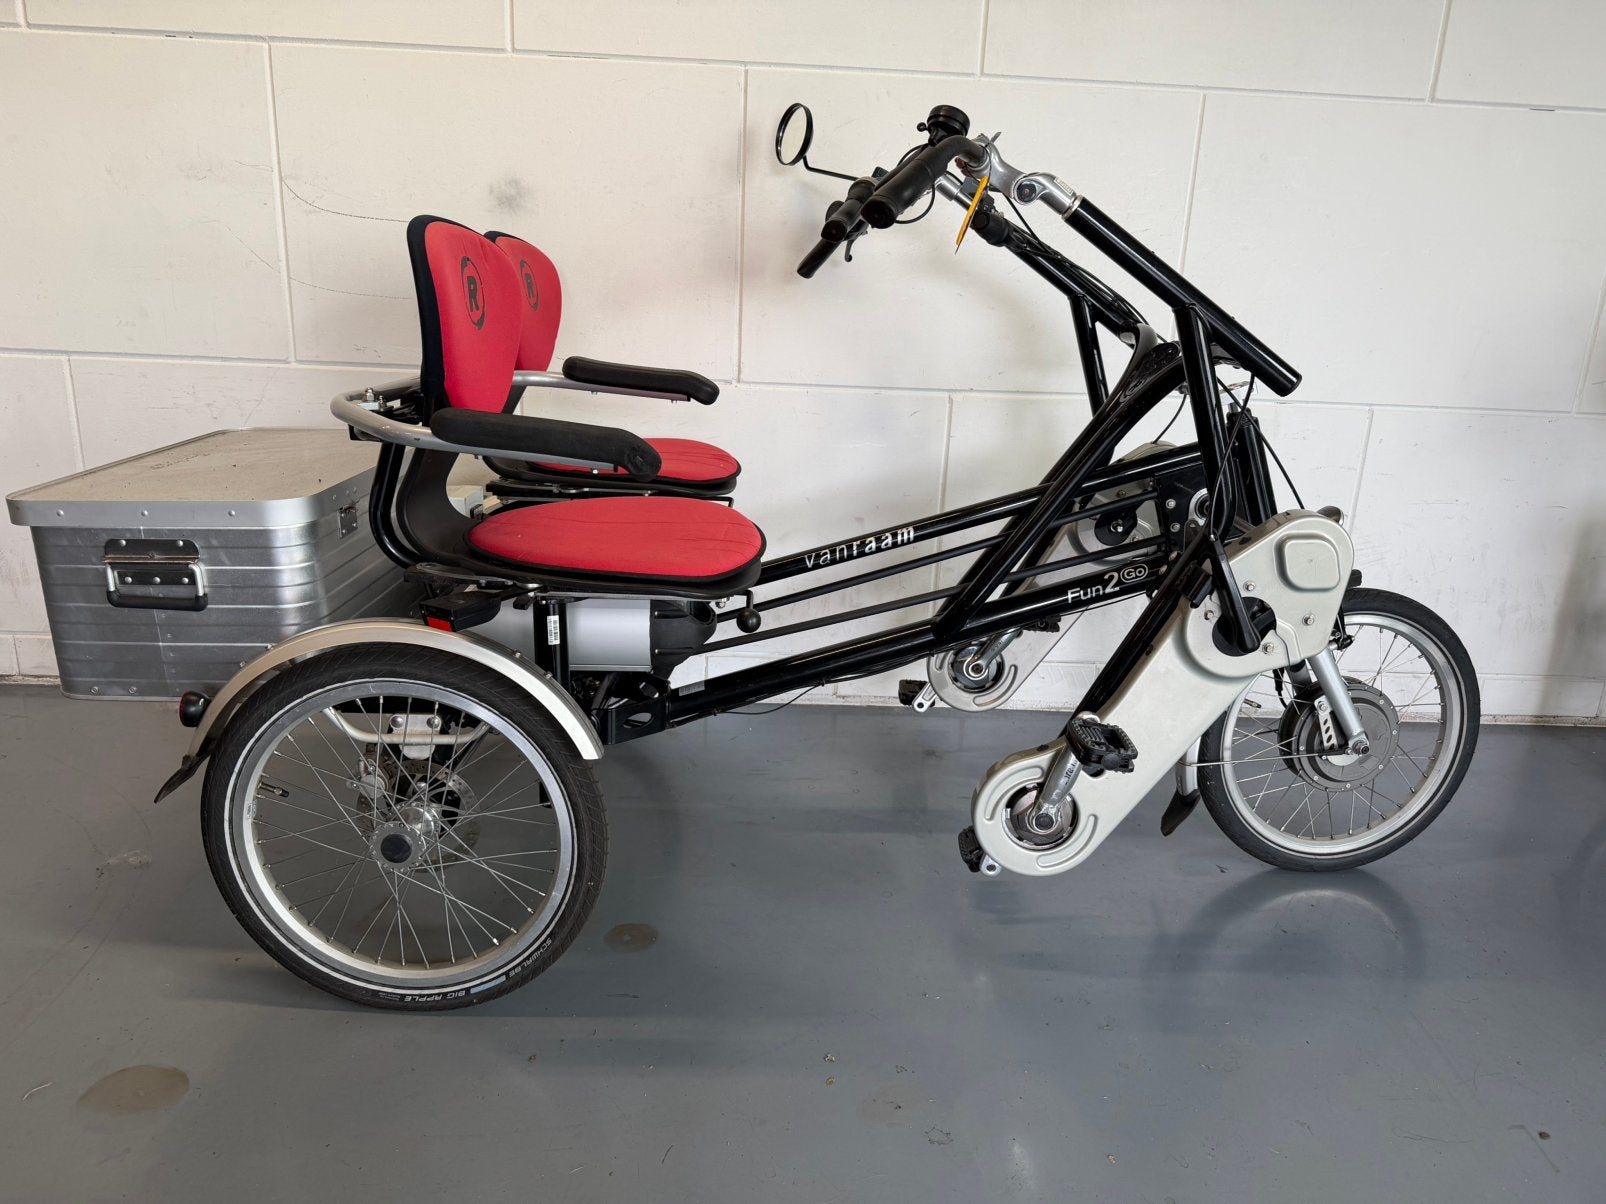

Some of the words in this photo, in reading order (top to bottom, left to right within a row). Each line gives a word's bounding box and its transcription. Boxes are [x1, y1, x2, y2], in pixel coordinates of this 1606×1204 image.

[1122, 566, 1147, 580] Go
[509, 939, 552, 977] SCHWALBE
[404, 993, 443, 1003] APPLE
[446, 990, 466, 1000] BIG
